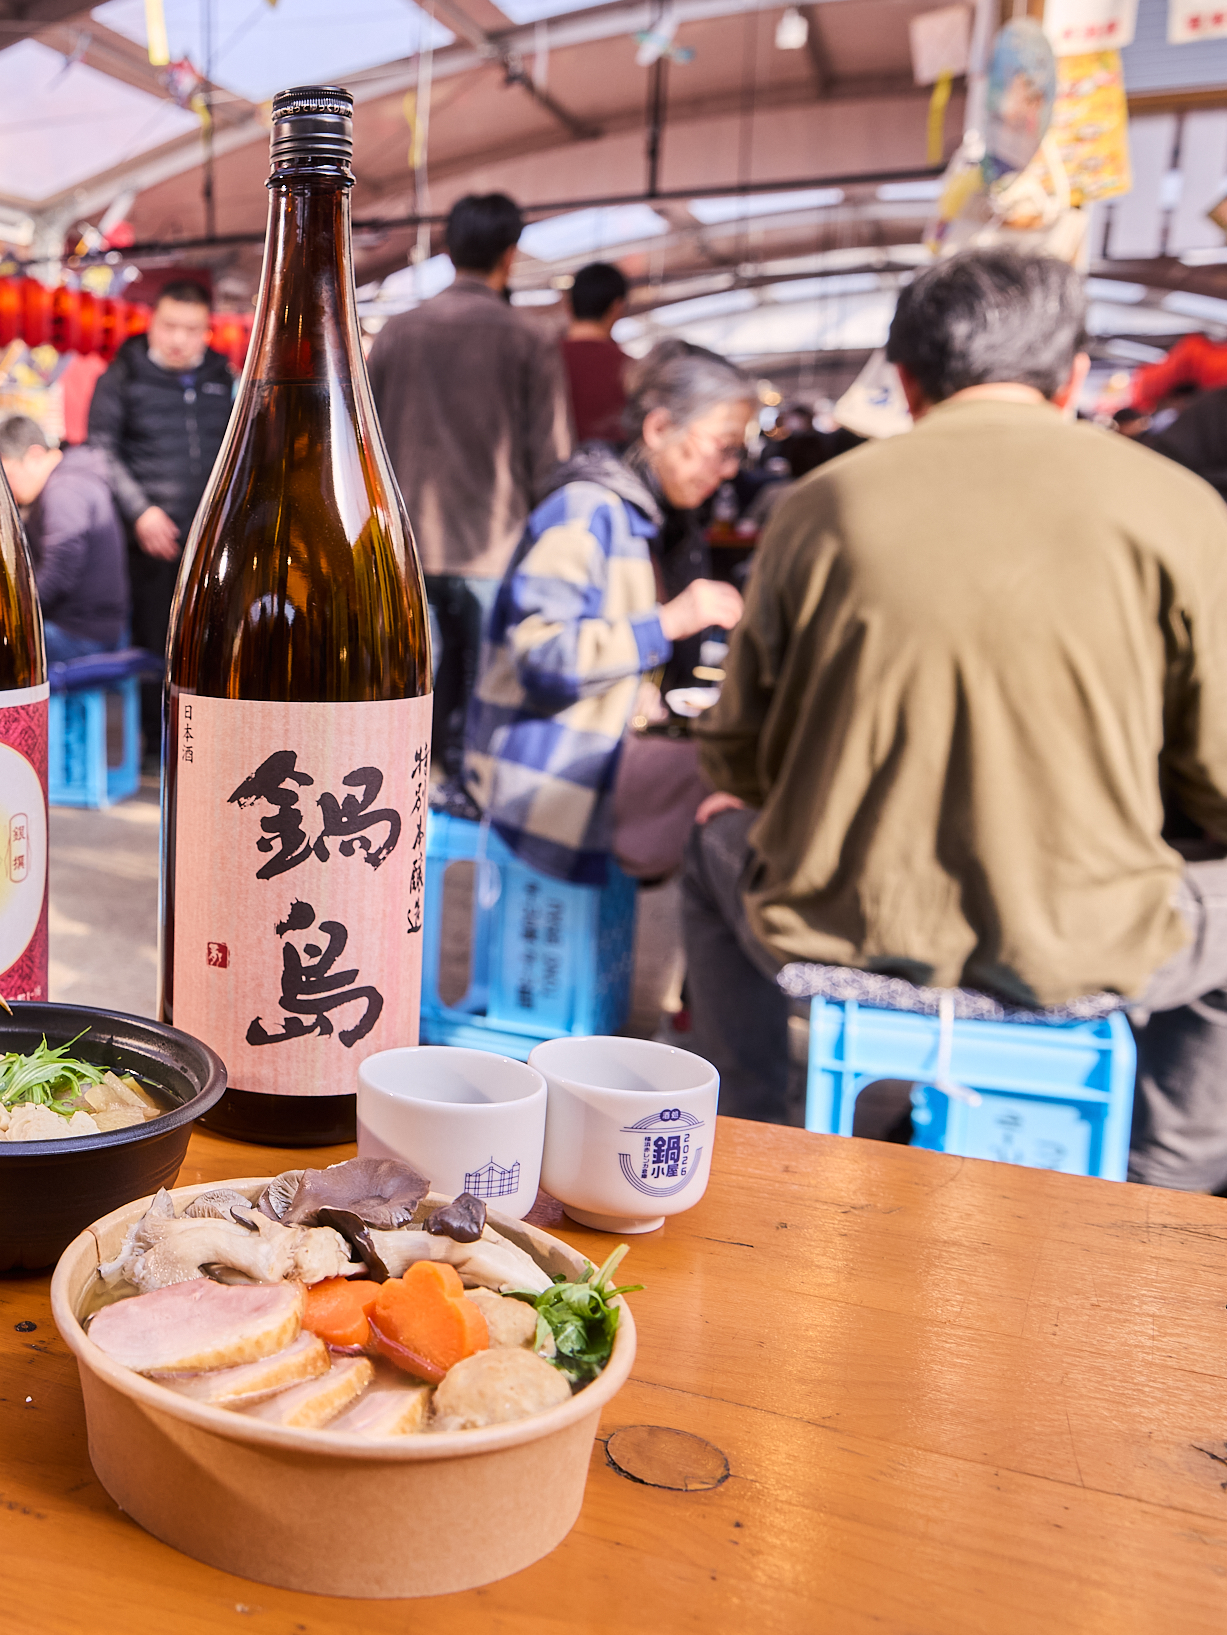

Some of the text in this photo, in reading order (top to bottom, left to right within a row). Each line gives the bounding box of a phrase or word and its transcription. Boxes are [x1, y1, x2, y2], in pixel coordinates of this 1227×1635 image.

[181, 704, 194, 763] 日本酒
[227, 750, 402, 1048] 鍋島
[651, 1164, 679, 1179] 小屋
[652, 1135, 681, 1165] 鍋
[680, 1133, 691, 1176] 2026
